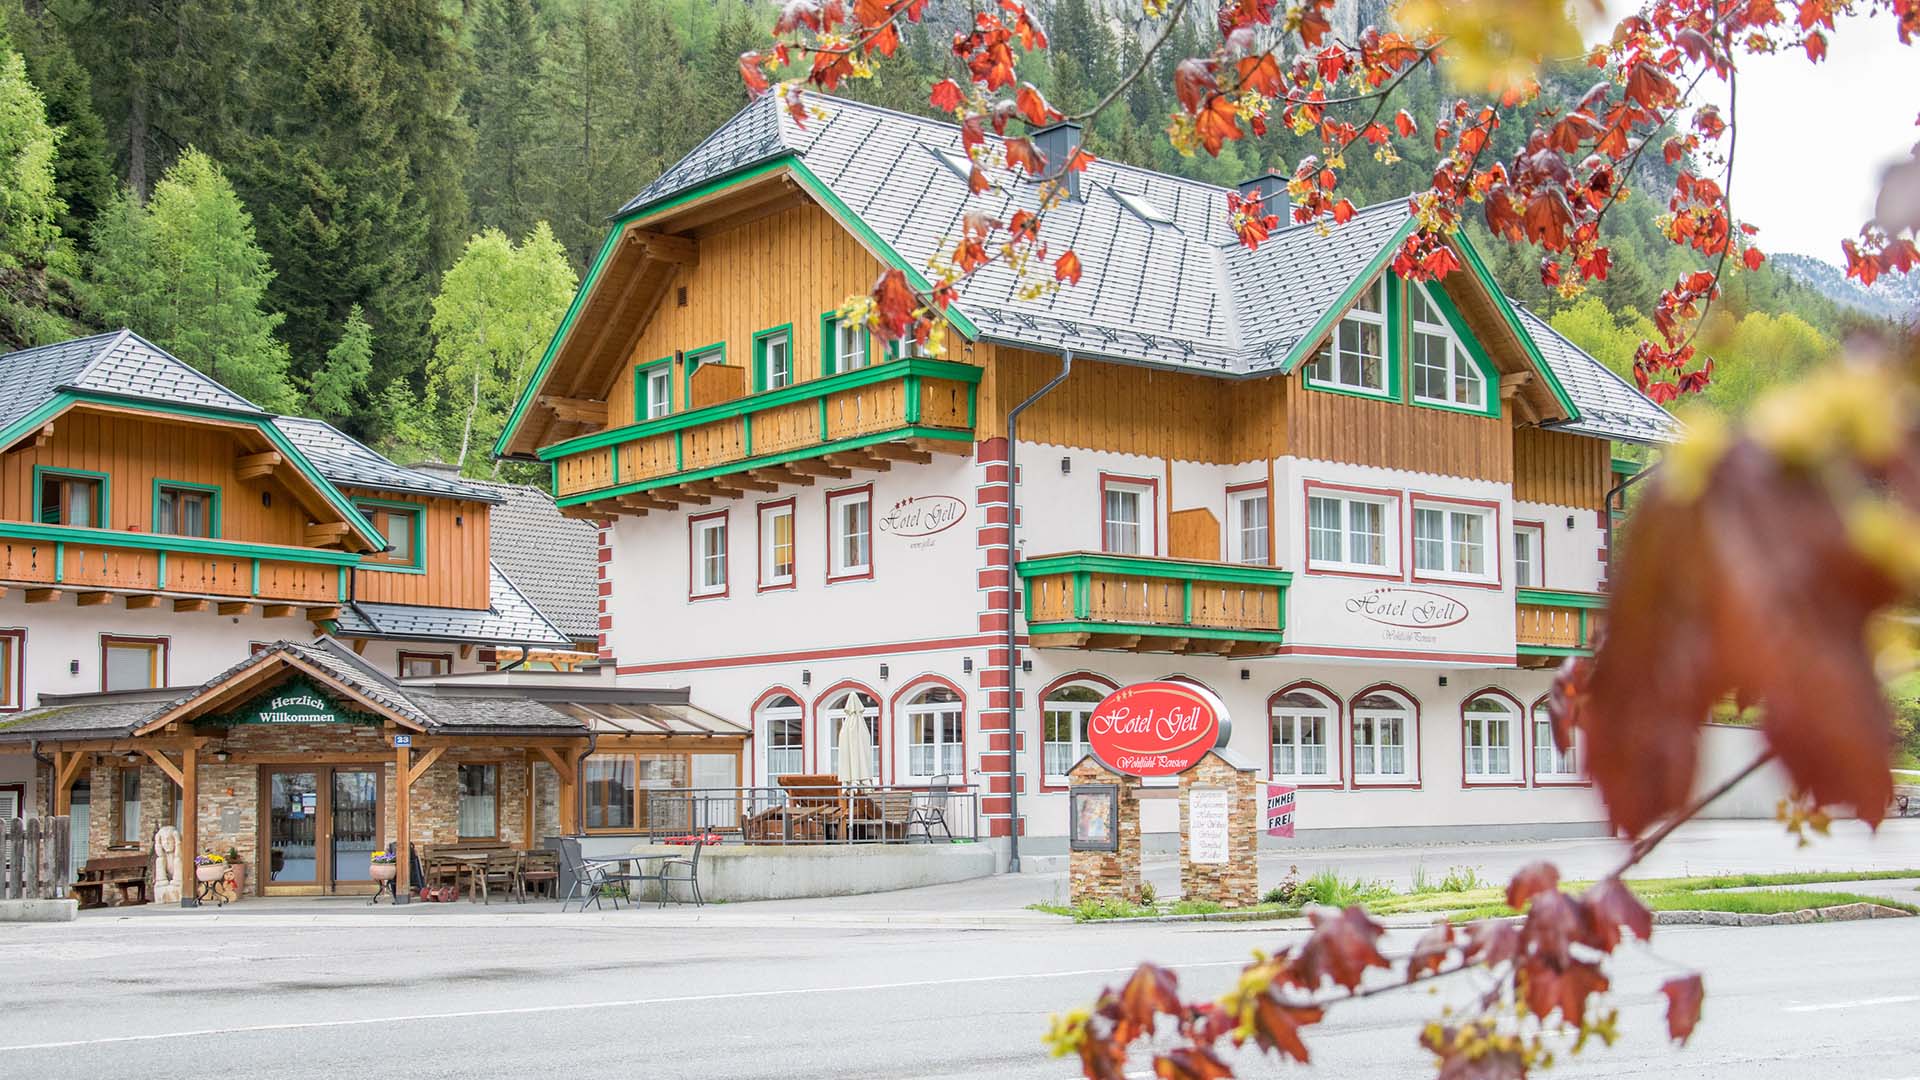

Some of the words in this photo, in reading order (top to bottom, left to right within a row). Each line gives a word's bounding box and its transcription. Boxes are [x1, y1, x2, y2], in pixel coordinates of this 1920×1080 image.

[879, 508, 921, 532] Hotel
[924, 502, 957, 530] Gell
[1345, 594, 1407, 616] Hotel
[1412, 600, 1456, 624] Gell
[271, 695, 325, 710] Herzlich
[259, 712, 335, 722] Willkommen
[1093, 706, 1154, 735] Hotel
[1155, 706, 1201, 741] Gell
[1267, 792, 1295, 809] ZIMMER
[1269, 813, 1291, 829] FREI
